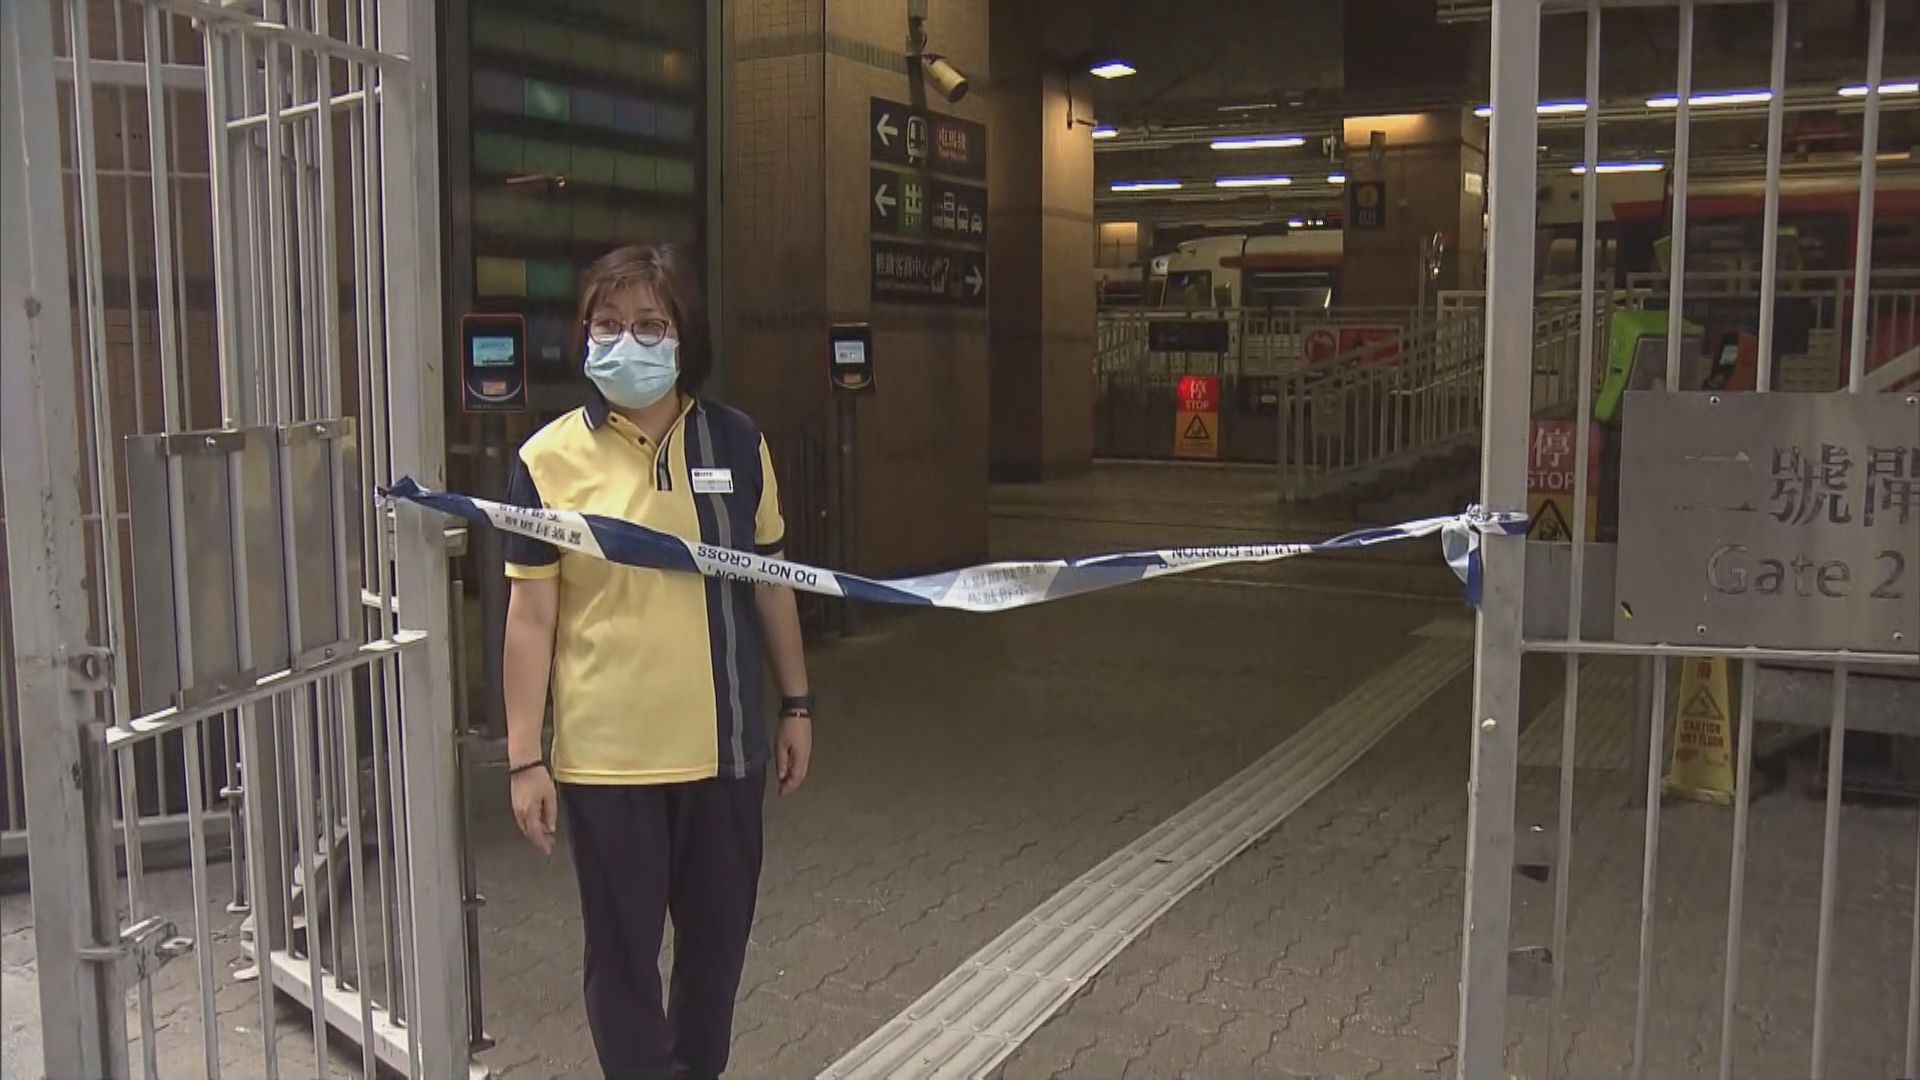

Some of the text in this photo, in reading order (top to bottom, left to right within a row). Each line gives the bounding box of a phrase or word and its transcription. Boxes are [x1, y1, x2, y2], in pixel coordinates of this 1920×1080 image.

[905, 184, 922, 213] 出
[1185, 400, 1209, 410] STOP
[1532, 427, 1571, 468] 停
[1527, 470, 1575, 490] STOP
[697, 546, 817, 587] DO NOT CROSS
[1706, 545, 1905, 599] Gate 2
[1683, 720, 1721, 735] CAUTION
